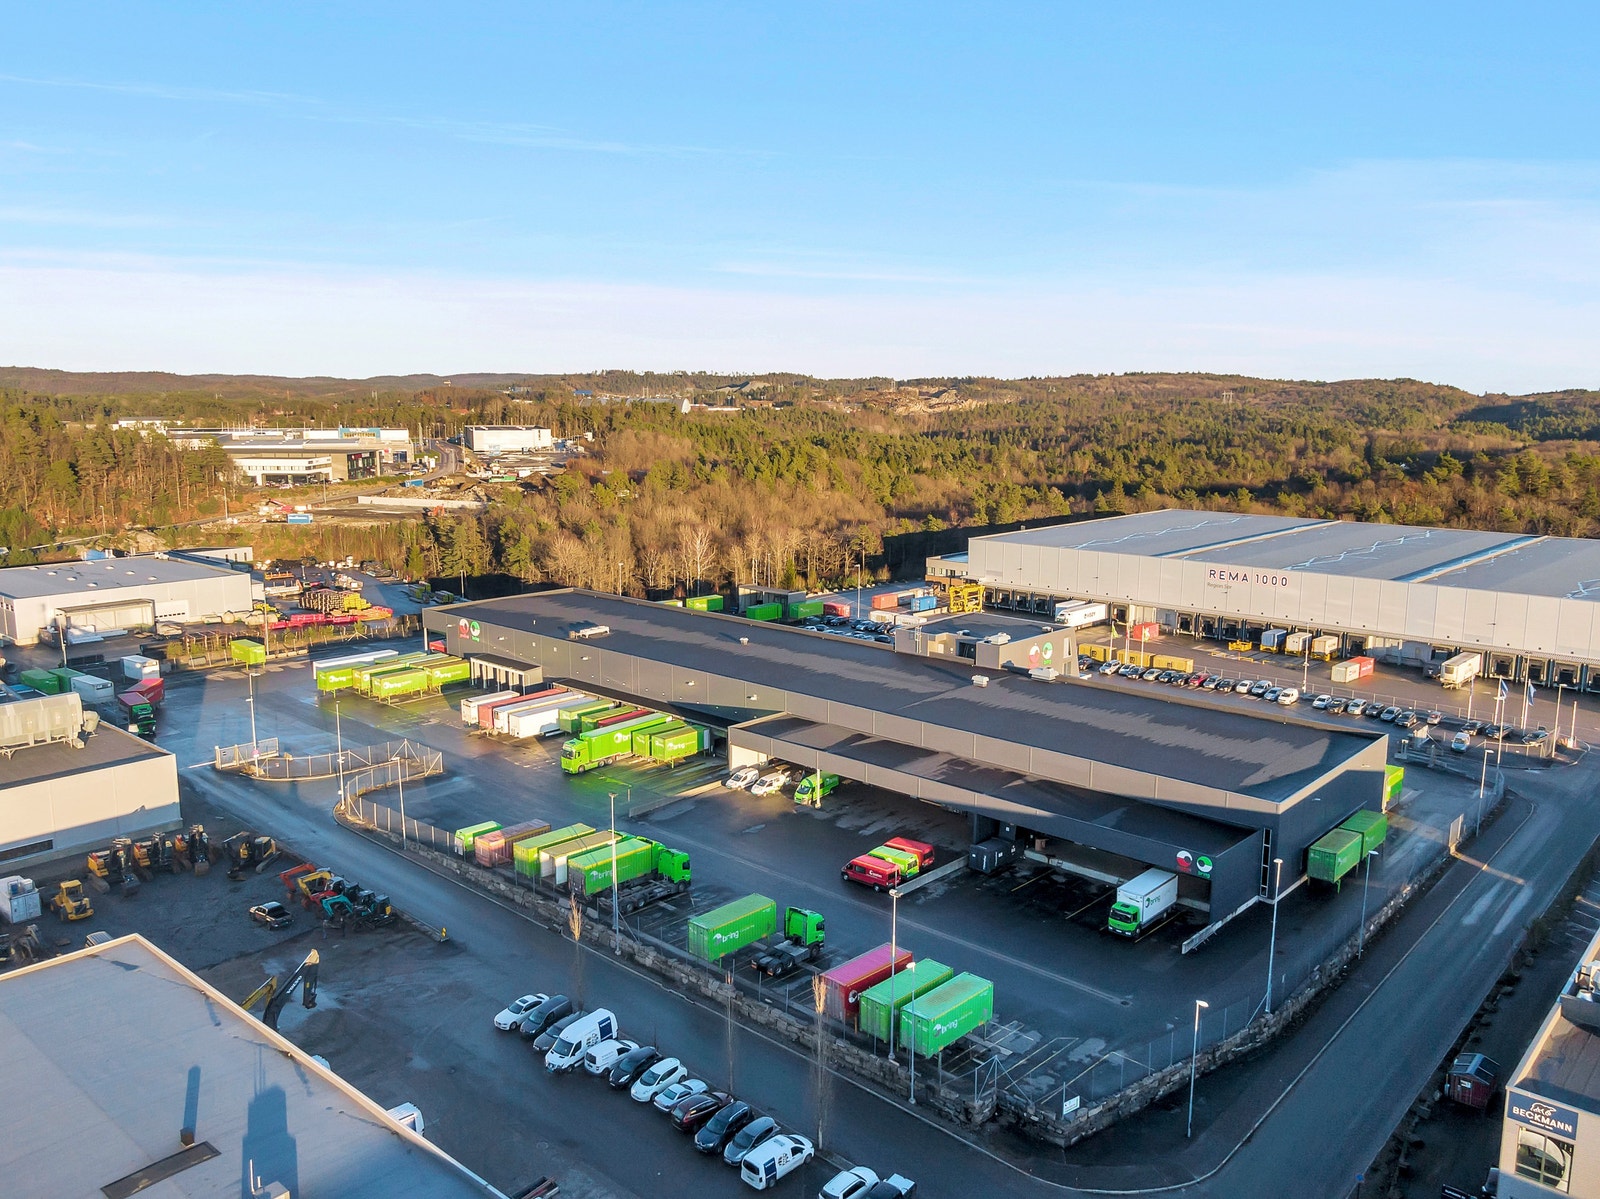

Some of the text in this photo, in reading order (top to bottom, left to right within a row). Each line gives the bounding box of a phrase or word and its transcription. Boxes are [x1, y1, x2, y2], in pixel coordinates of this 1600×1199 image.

[1209, 569, 1288, 587] REMA 1000
[722, 930, 739, 943] bring
[941, 1019, 958, 1034] bring
[1512, 1106, 1573, 1133] BECKMANN
